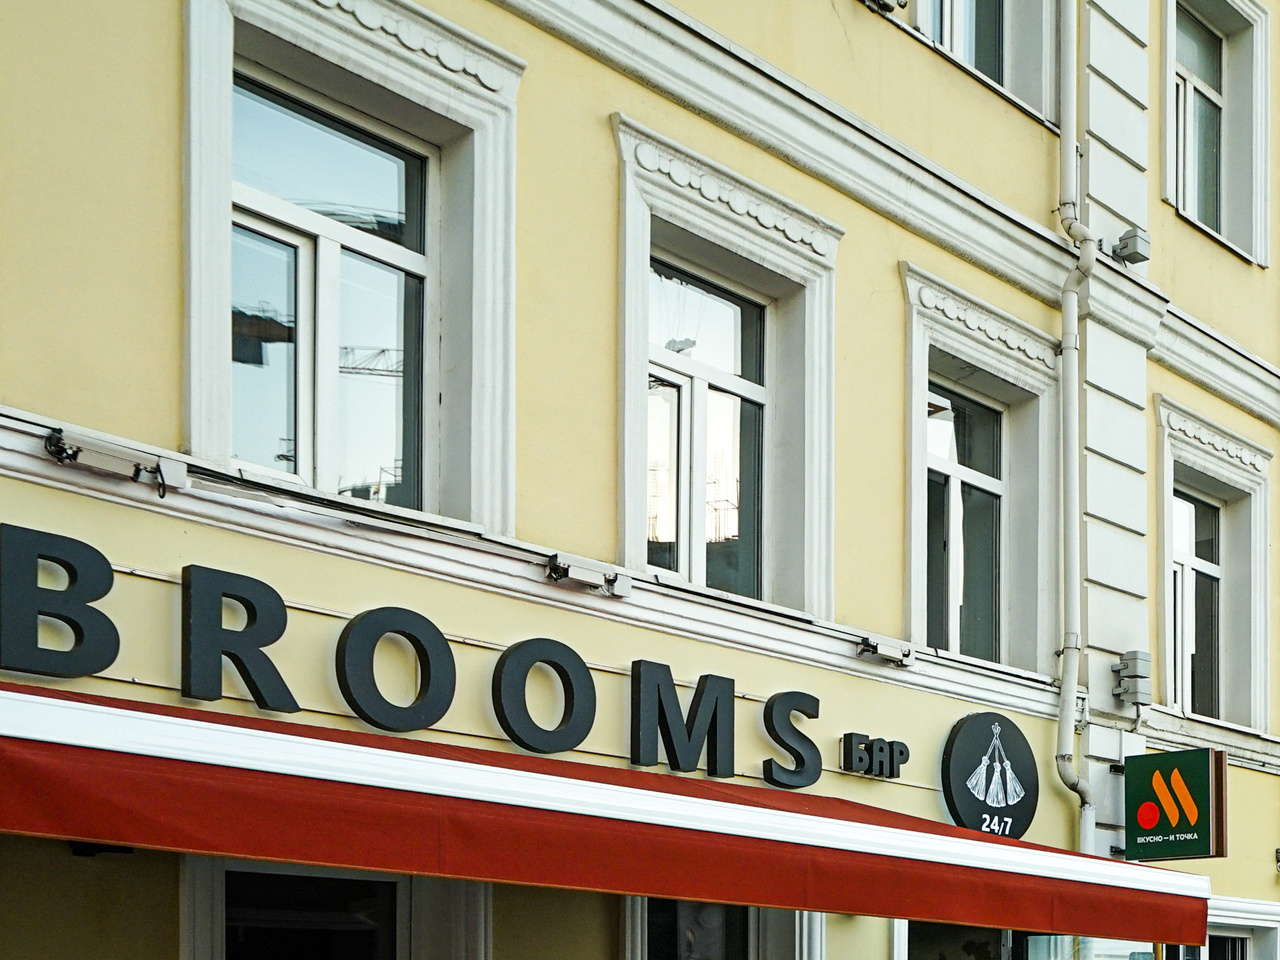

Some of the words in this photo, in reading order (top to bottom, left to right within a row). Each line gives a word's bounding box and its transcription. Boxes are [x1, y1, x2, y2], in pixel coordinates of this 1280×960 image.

[0, 522, 822, 790] BROOMS
[843, 732, 910, 779] БАР
[981, 813, 1013, 836] 24/7
[1136, 835, 1163, 844] ВКУСНО
[1175, 832, 1199, 841] ТОЧКА
